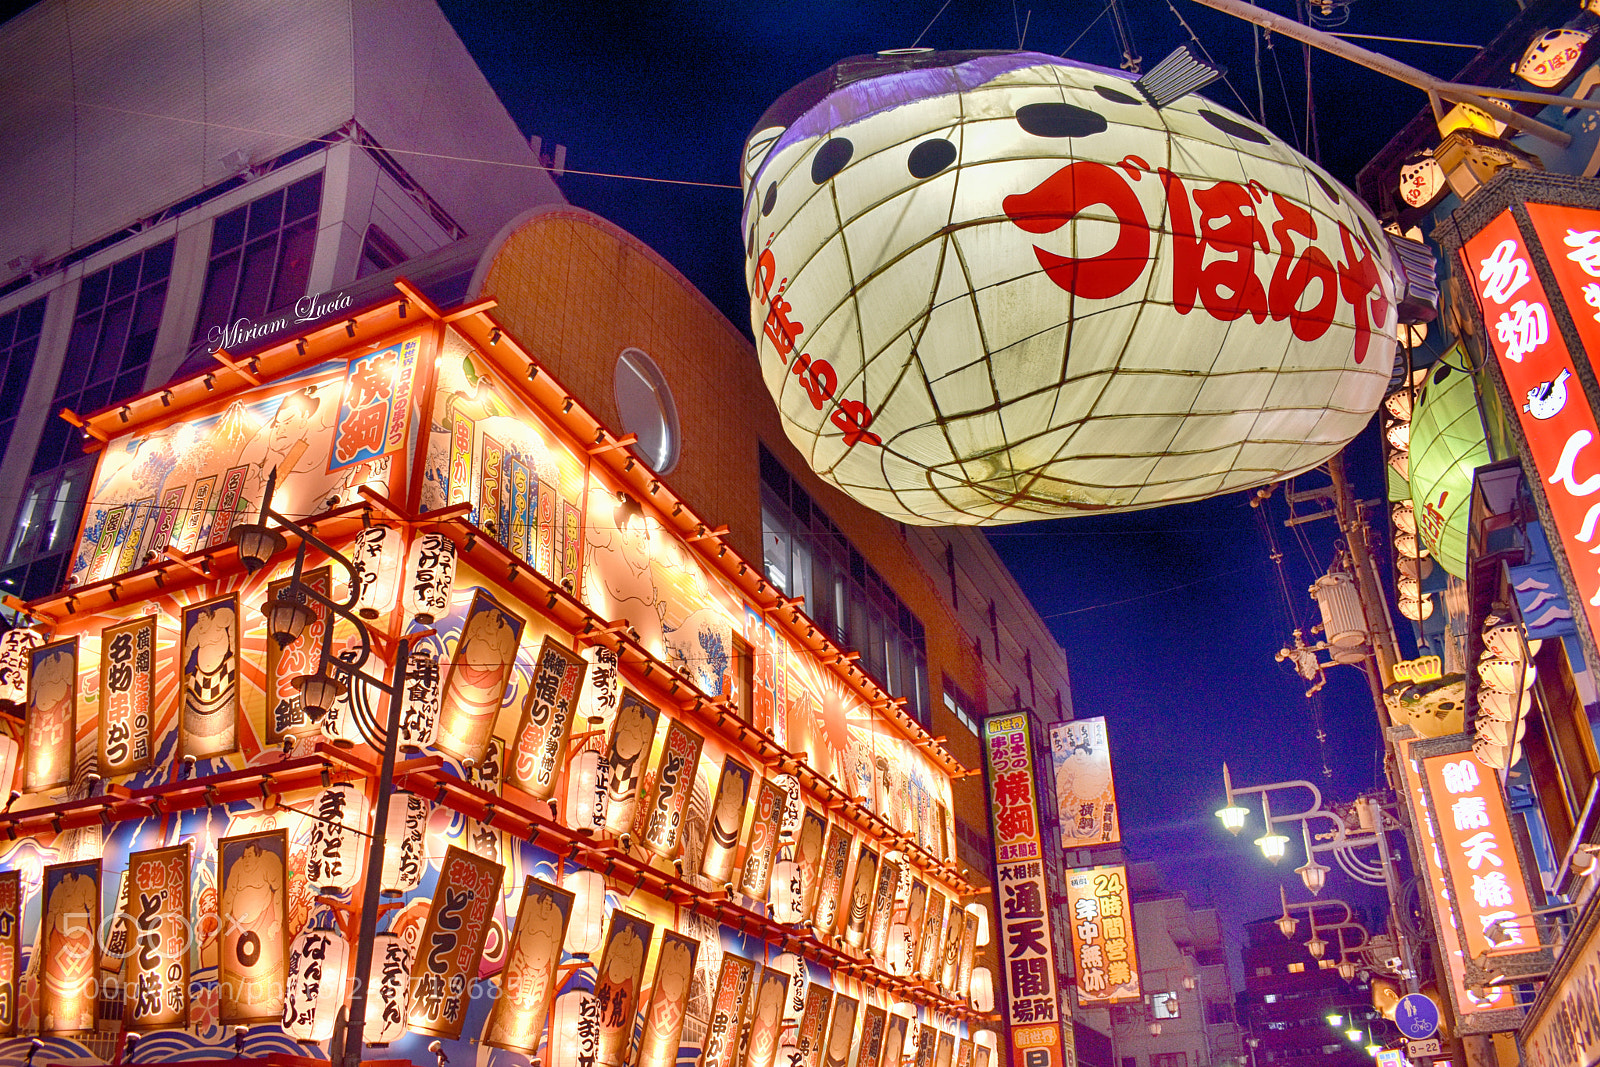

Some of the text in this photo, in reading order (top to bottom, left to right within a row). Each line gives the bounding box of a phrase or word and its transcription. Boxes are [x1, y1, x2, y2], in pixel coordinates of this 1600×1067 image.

[1002, 154, 1388, 363] づぼらや
[336, 350, 398, 462] 横綱
[388, 368, 413, 445] 日本一の串かつ
[107, 632, 134, 767] 名物串かつ
[988, 715, 1025, 734] 新世界
[990, 735, 1010, 771] 串かつ
[1009, 732, 1028, 769] 日本一の
[993, 770, 1035, 842] 横綱
[134, 890, 169, 1020] どて焼
[167, 858, 185, 1013] 大阪下町の味
[410, 887, 474, 1023] どて焼
[443, 872, 494, 1024] 大阪下町の味
[1004, 880, 1051, 999] 通天閣
[1075, 898, 1106, 993] 年中無休
[1094, 873, 1132, 986] 24時間営業
[1012, 998, 1055, 1023] 場所
[1410, 1042, 1438, 1054] 9-22
